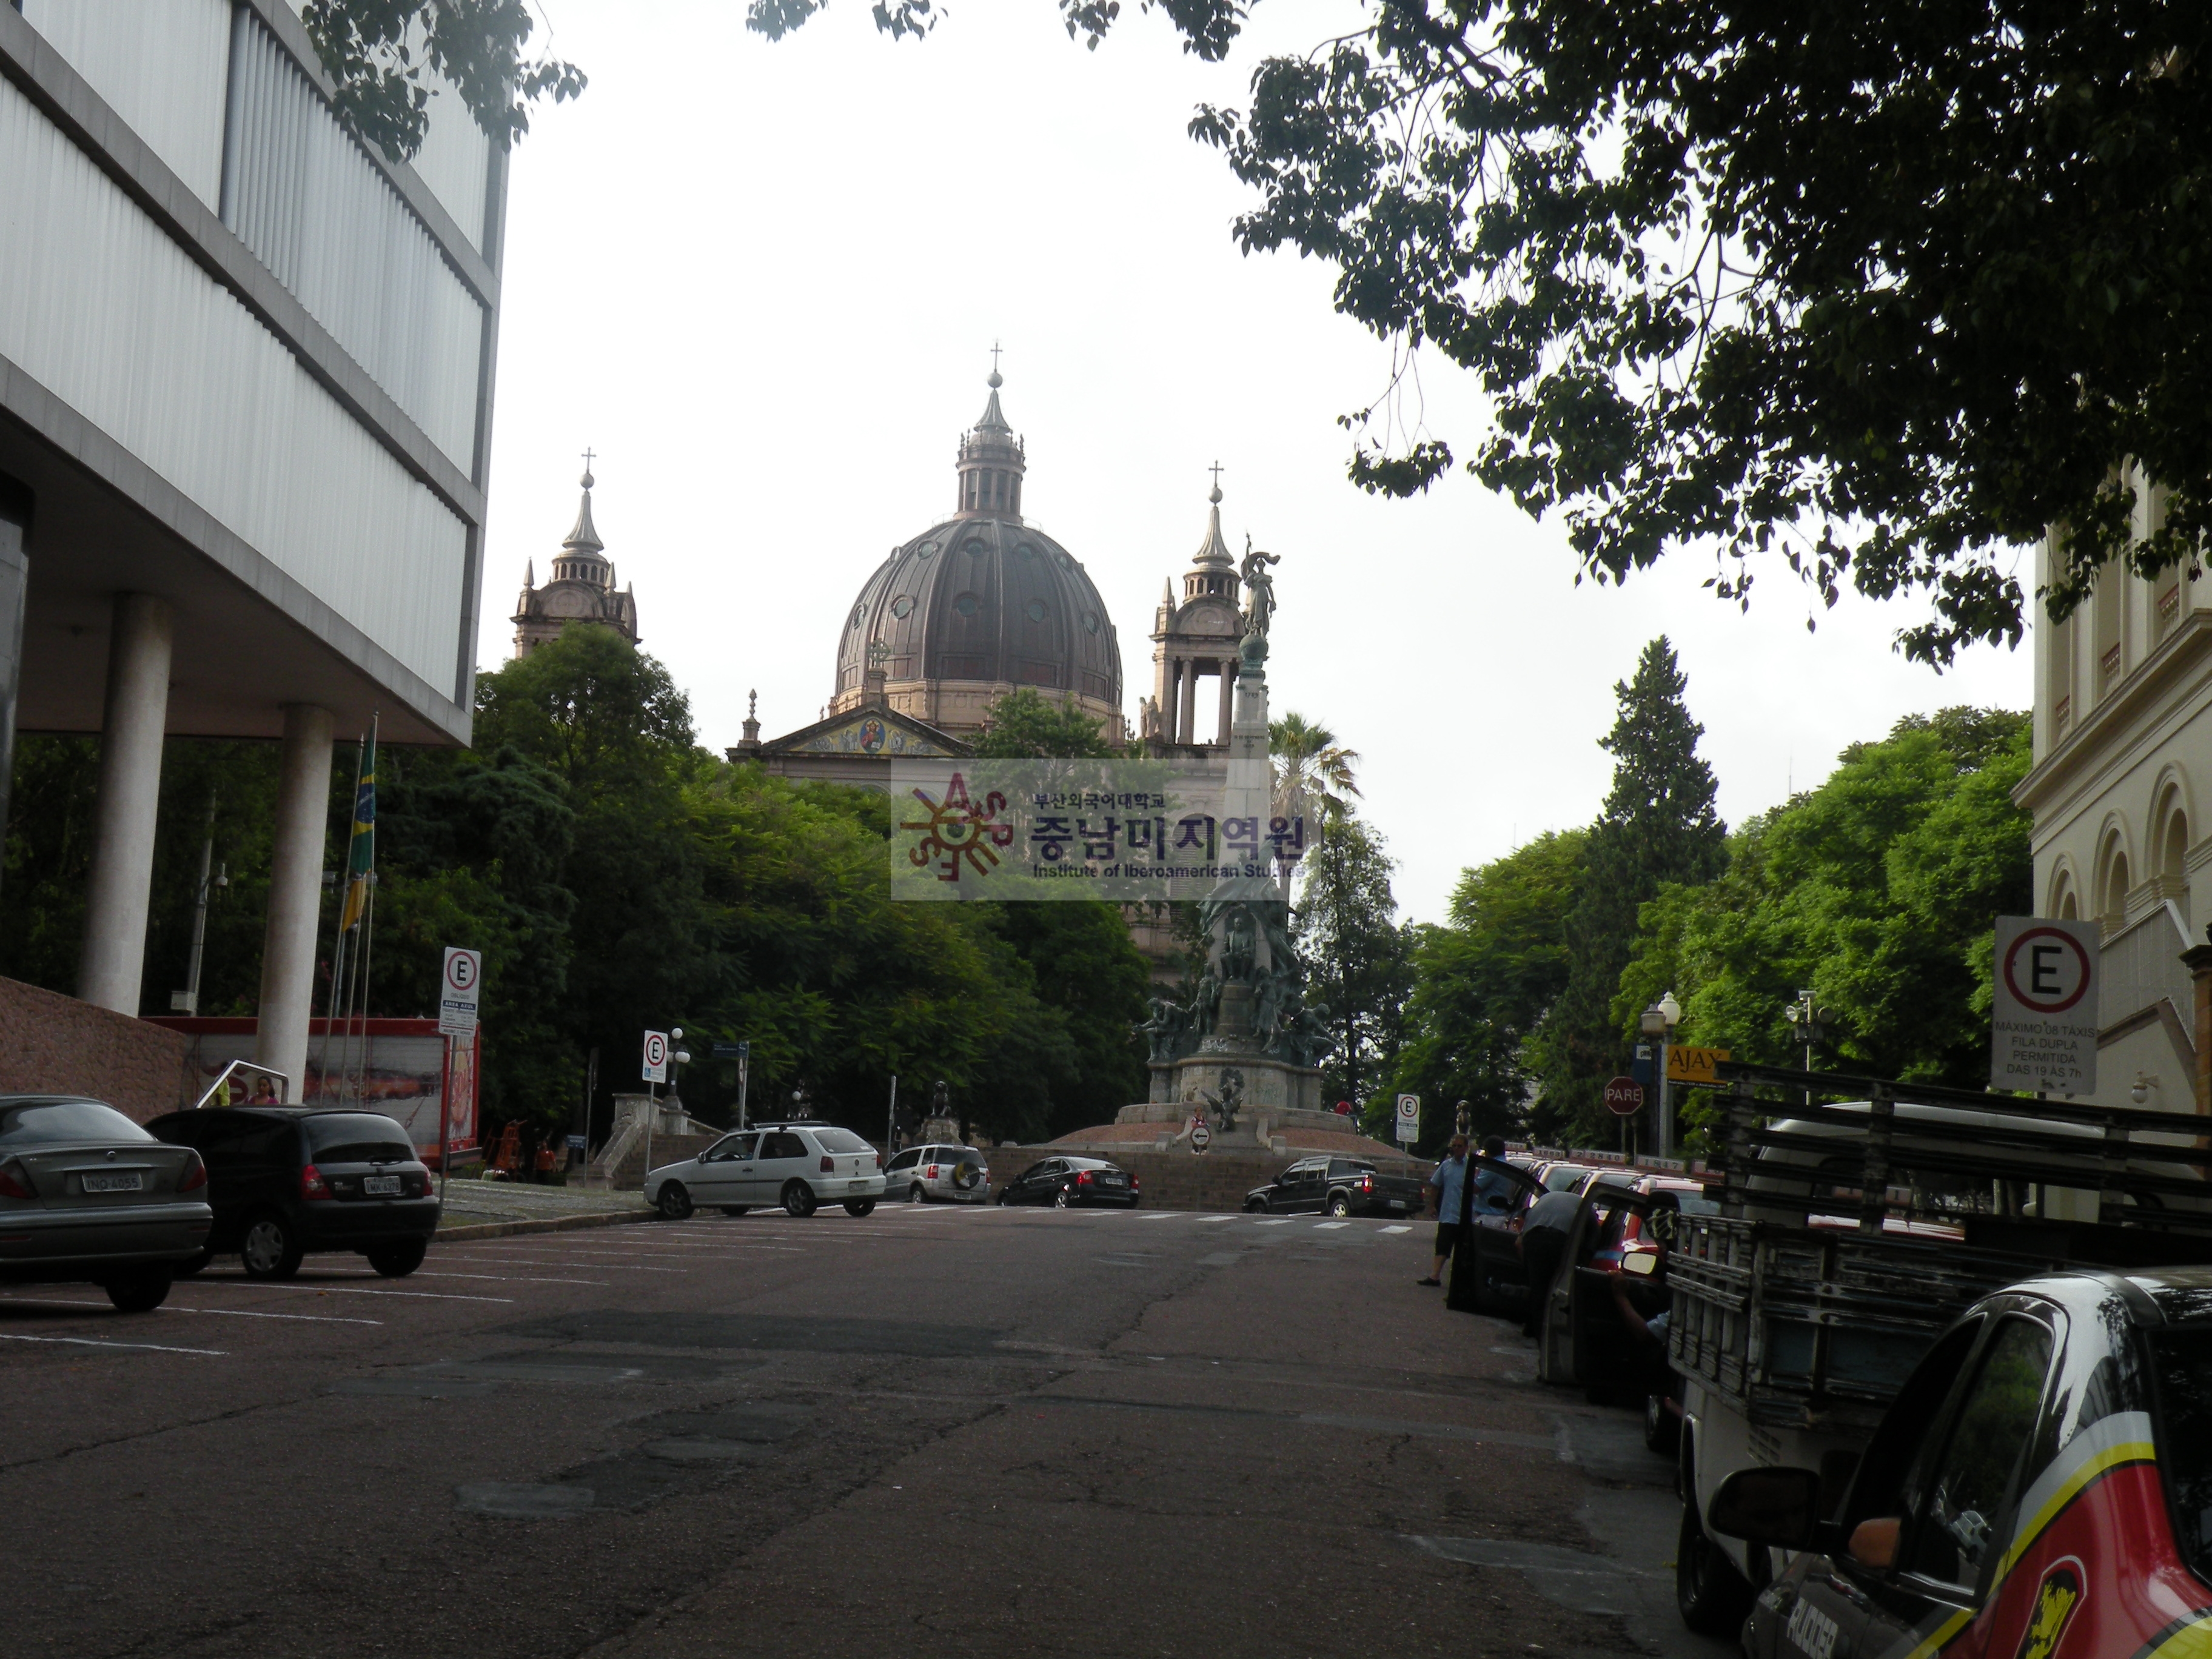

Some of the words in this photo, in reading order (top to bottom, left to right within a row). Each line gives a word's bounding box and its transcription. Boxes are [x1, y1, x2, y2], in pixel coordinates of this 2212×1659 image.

[457, 960, 468, 981] E
[2031, 945, 2062, 994] E
[2045, 1025, 2058, 1034] 08
[652, 1041, 660, 1059] E
[2012, 1037, 2036, 1048] FILA
[2039, 1039, 2079, 1050] DUPLA
[1669, 1049, 1721, 1073] AJAX
[2013, 1051, 2076, 1064] PERMITIDA
[2007, 1064, 2030, 1076] DAS
[2035, 1065, 2047, 1076] 19
[2069, 1068, 2082, 1079] 7h
[1607, 1088, 1640, 1101] PARE
[1406, 1101, 1412, 1112] E
